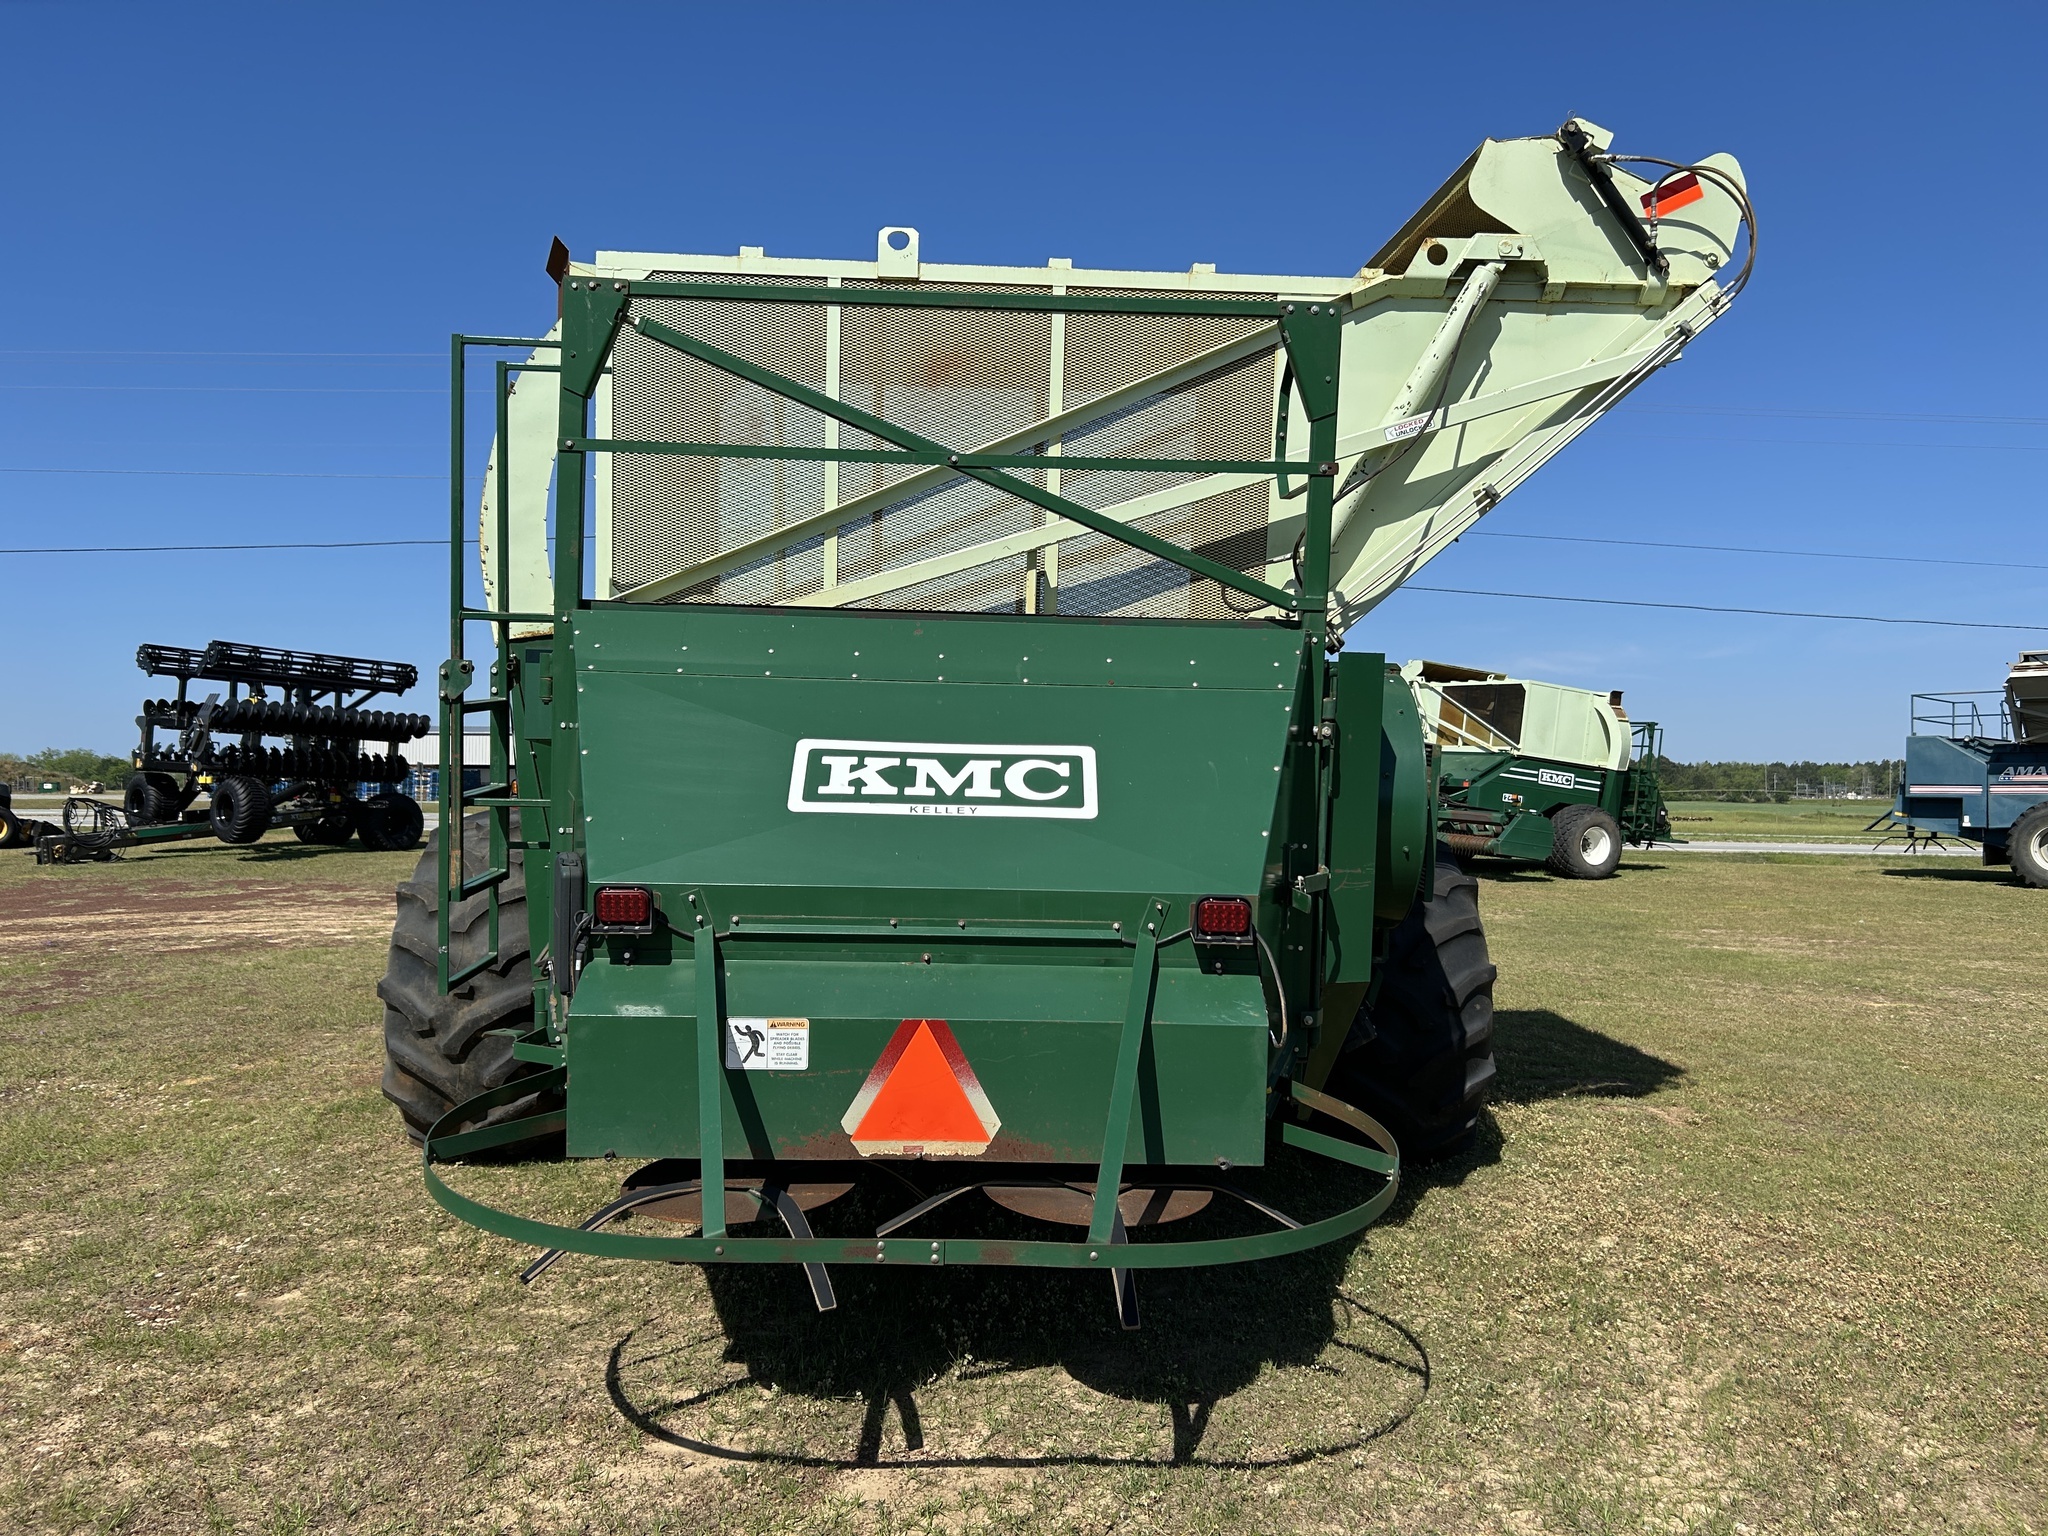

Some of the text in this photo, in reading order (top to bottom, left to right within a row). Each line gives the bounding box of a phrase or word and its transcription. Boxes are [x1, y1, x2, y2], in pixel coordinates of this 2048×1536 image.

[1394, 418, 1424, 431] LOCKED
[1395, 423, 1432, 437] UNLOCKD
[817, 755, 1070, 801] KMC
[1541, 772, 1572, 785] KMC
[909, 805, 978, 815] KELLEY
